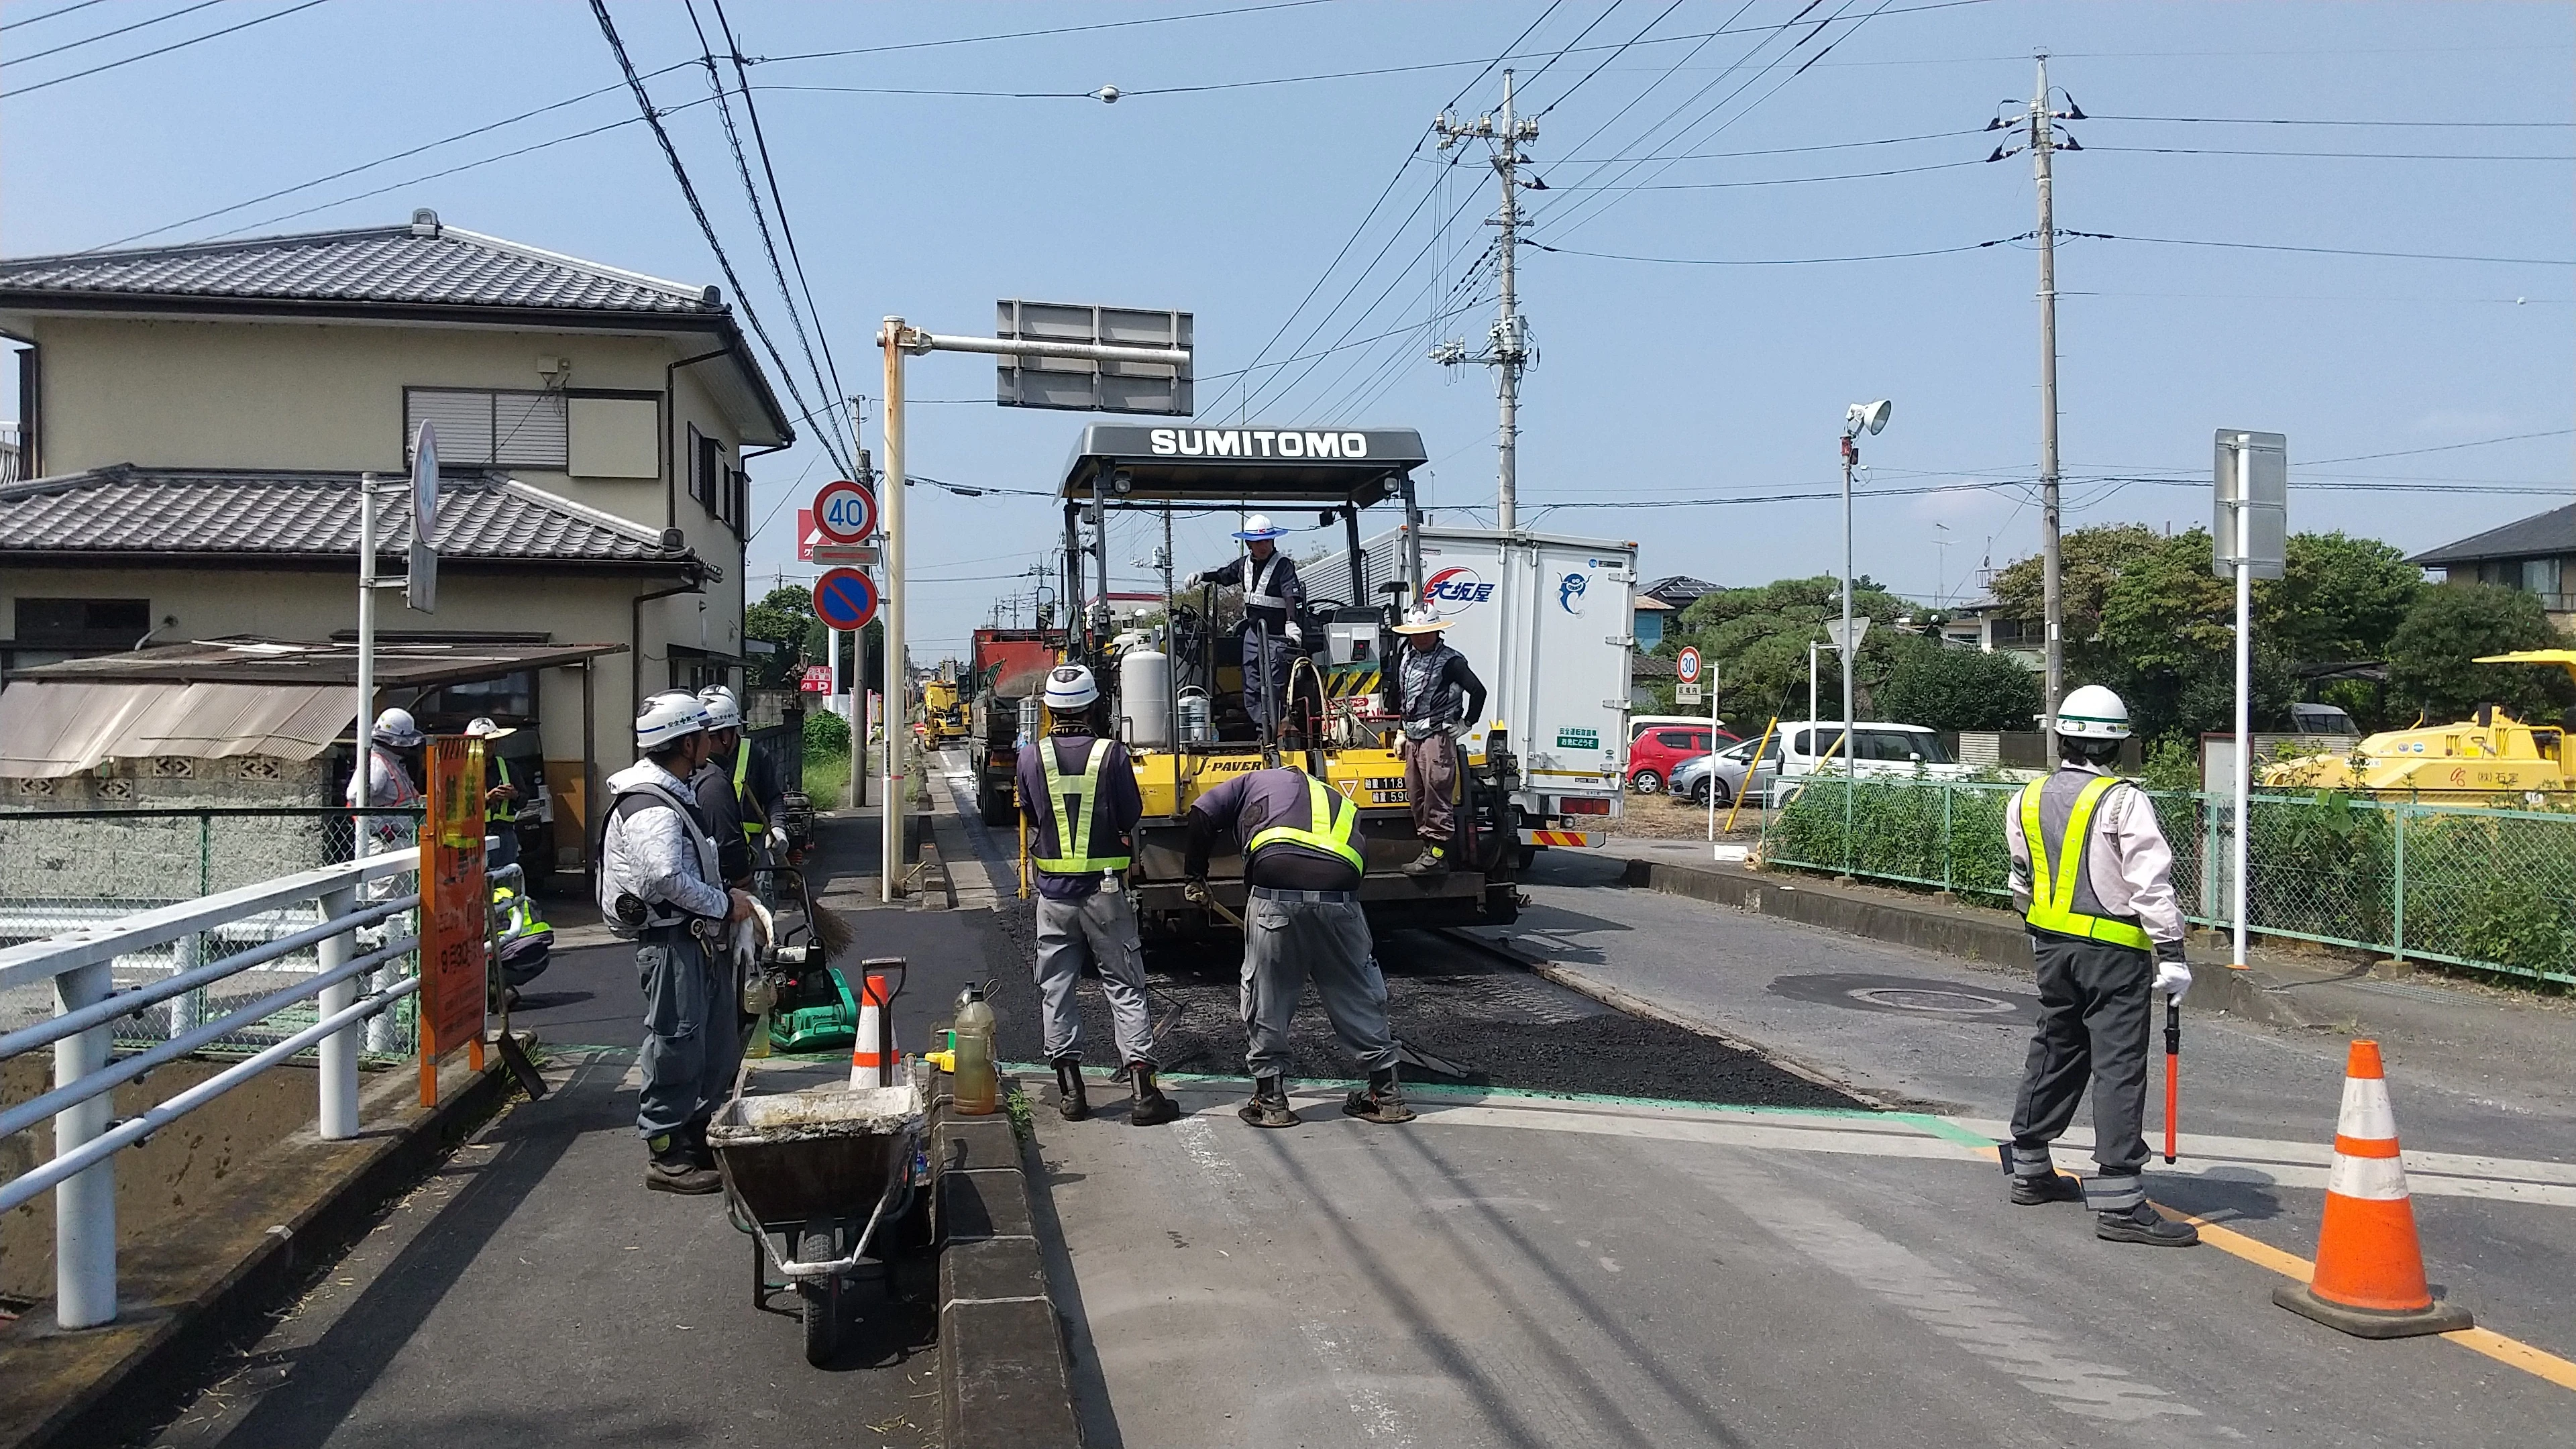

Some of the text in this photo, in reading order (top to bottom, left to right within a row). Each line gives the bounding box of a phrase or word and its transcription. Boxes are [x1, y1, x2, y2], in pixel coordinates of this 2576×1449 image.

[1150, 429, 1367, 458] SUMITOMO
[828, 498, 862, 527] 40
[1426, 581, 1496, 602] 大坂屋
[1682, 657, 1695, 674] 30
[1561, 739, 1594, 747] お先にどうぞ
